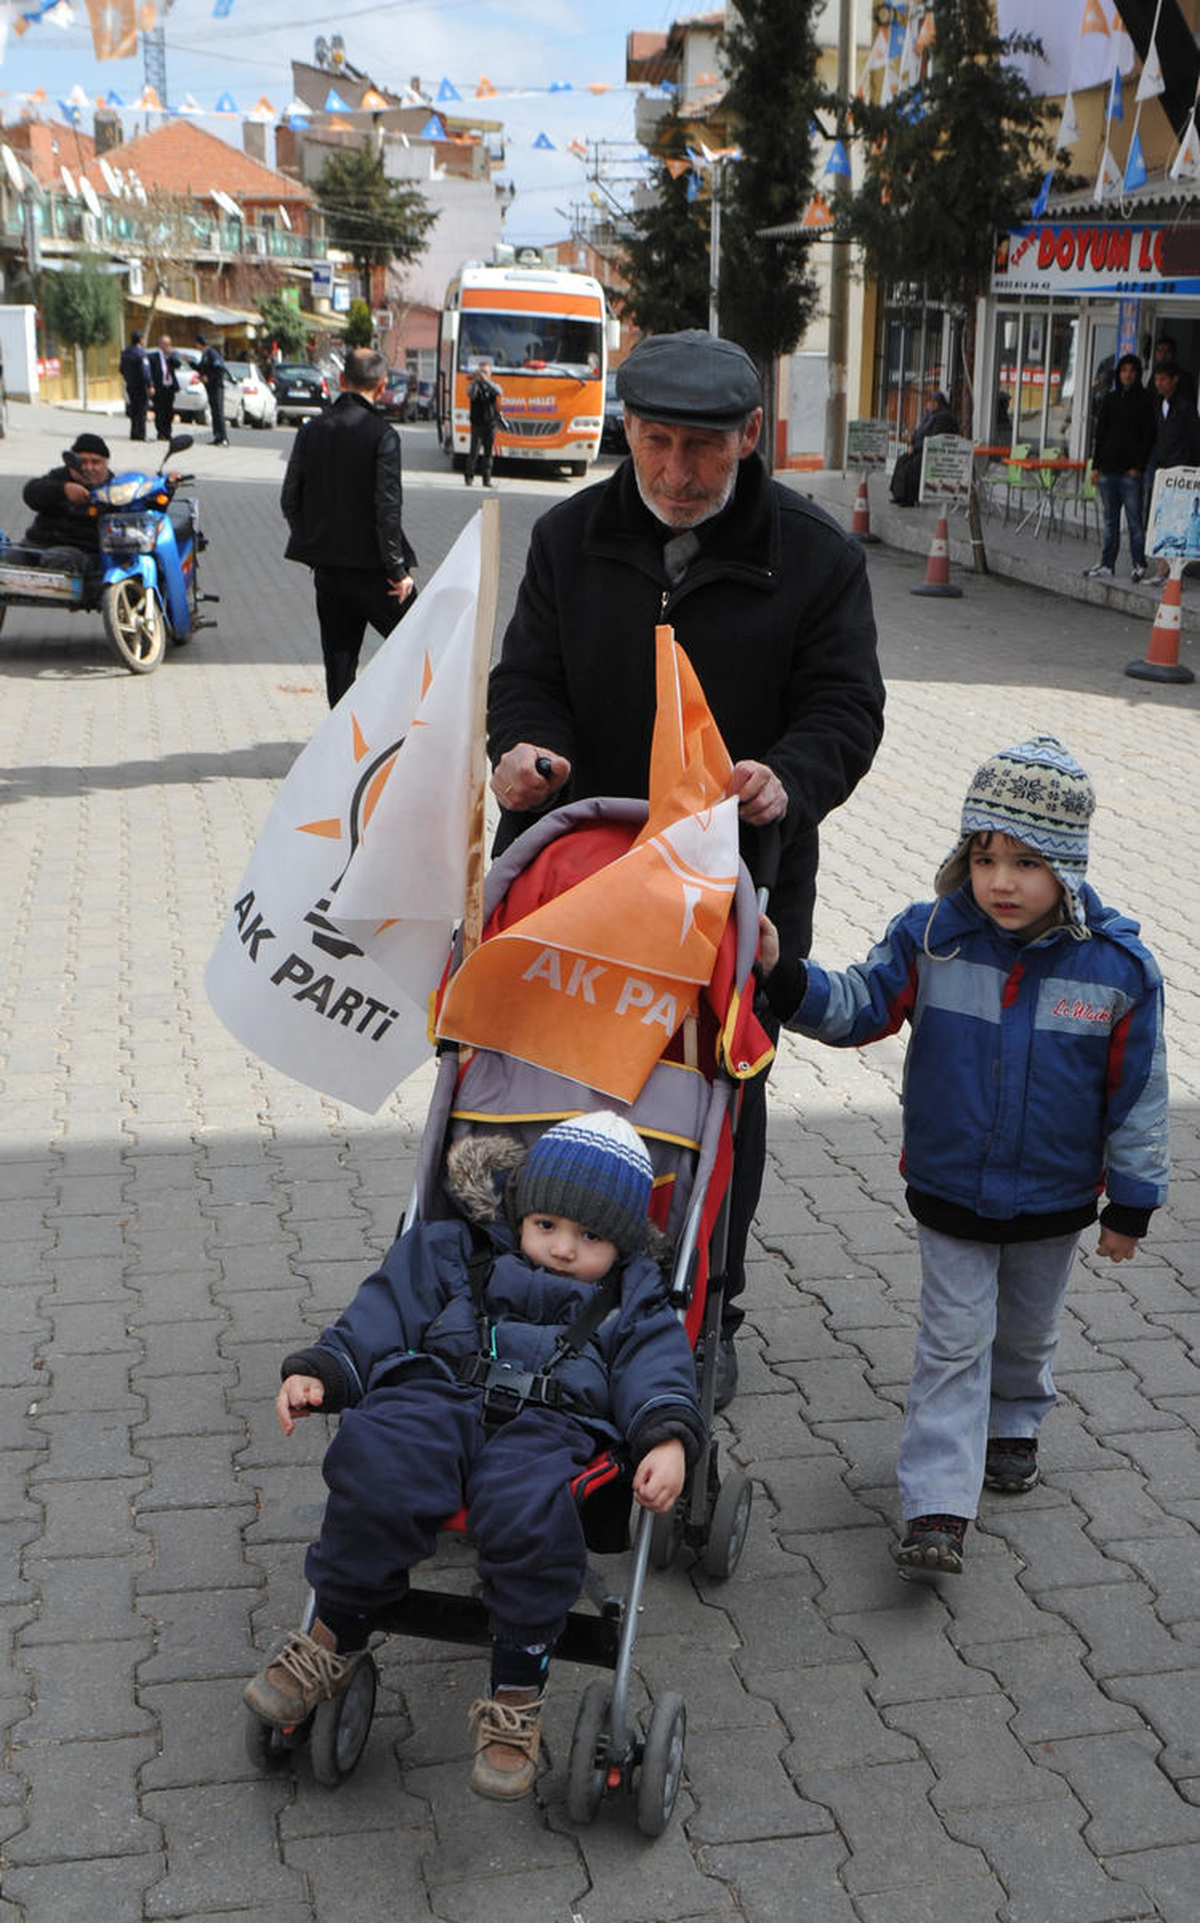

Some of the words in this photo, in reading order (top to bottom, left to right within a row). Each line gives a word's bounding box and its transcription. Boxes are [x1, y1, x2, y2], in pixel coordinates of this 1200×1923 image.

[1037, 227, 1132, 272] DOYUM
[234, 890, 276, 963] AK
[521, 948, 607, 1005] AK
[614, 976, 690, 1038] PA
